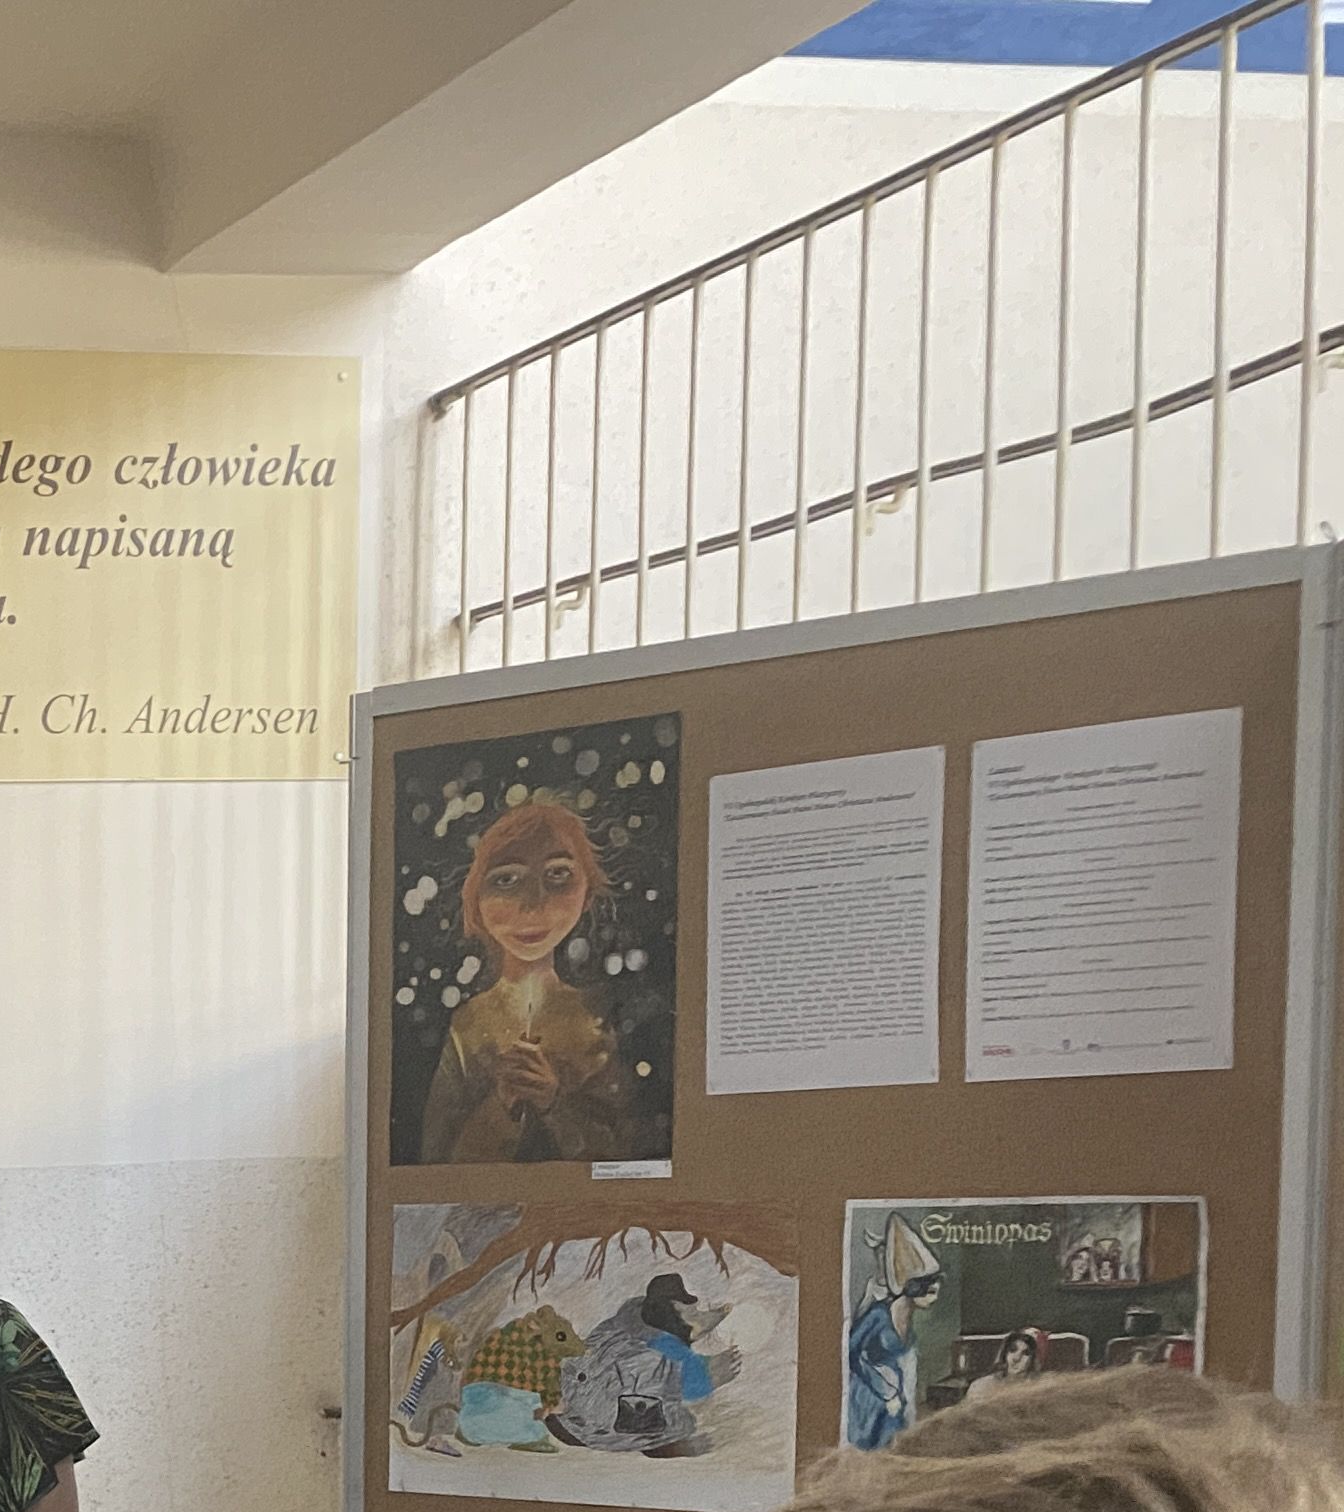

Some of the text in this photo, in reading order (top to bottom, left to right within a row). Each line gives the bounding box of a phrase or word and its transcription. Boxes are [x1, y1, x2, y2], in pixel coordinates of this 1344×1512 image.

[114, 443, 337, 490] człowieka
[22, 514, 234, 569] napisaną
[41, 693, 108, 735] Ch.
[125, 694, 319, 735] Andersen
